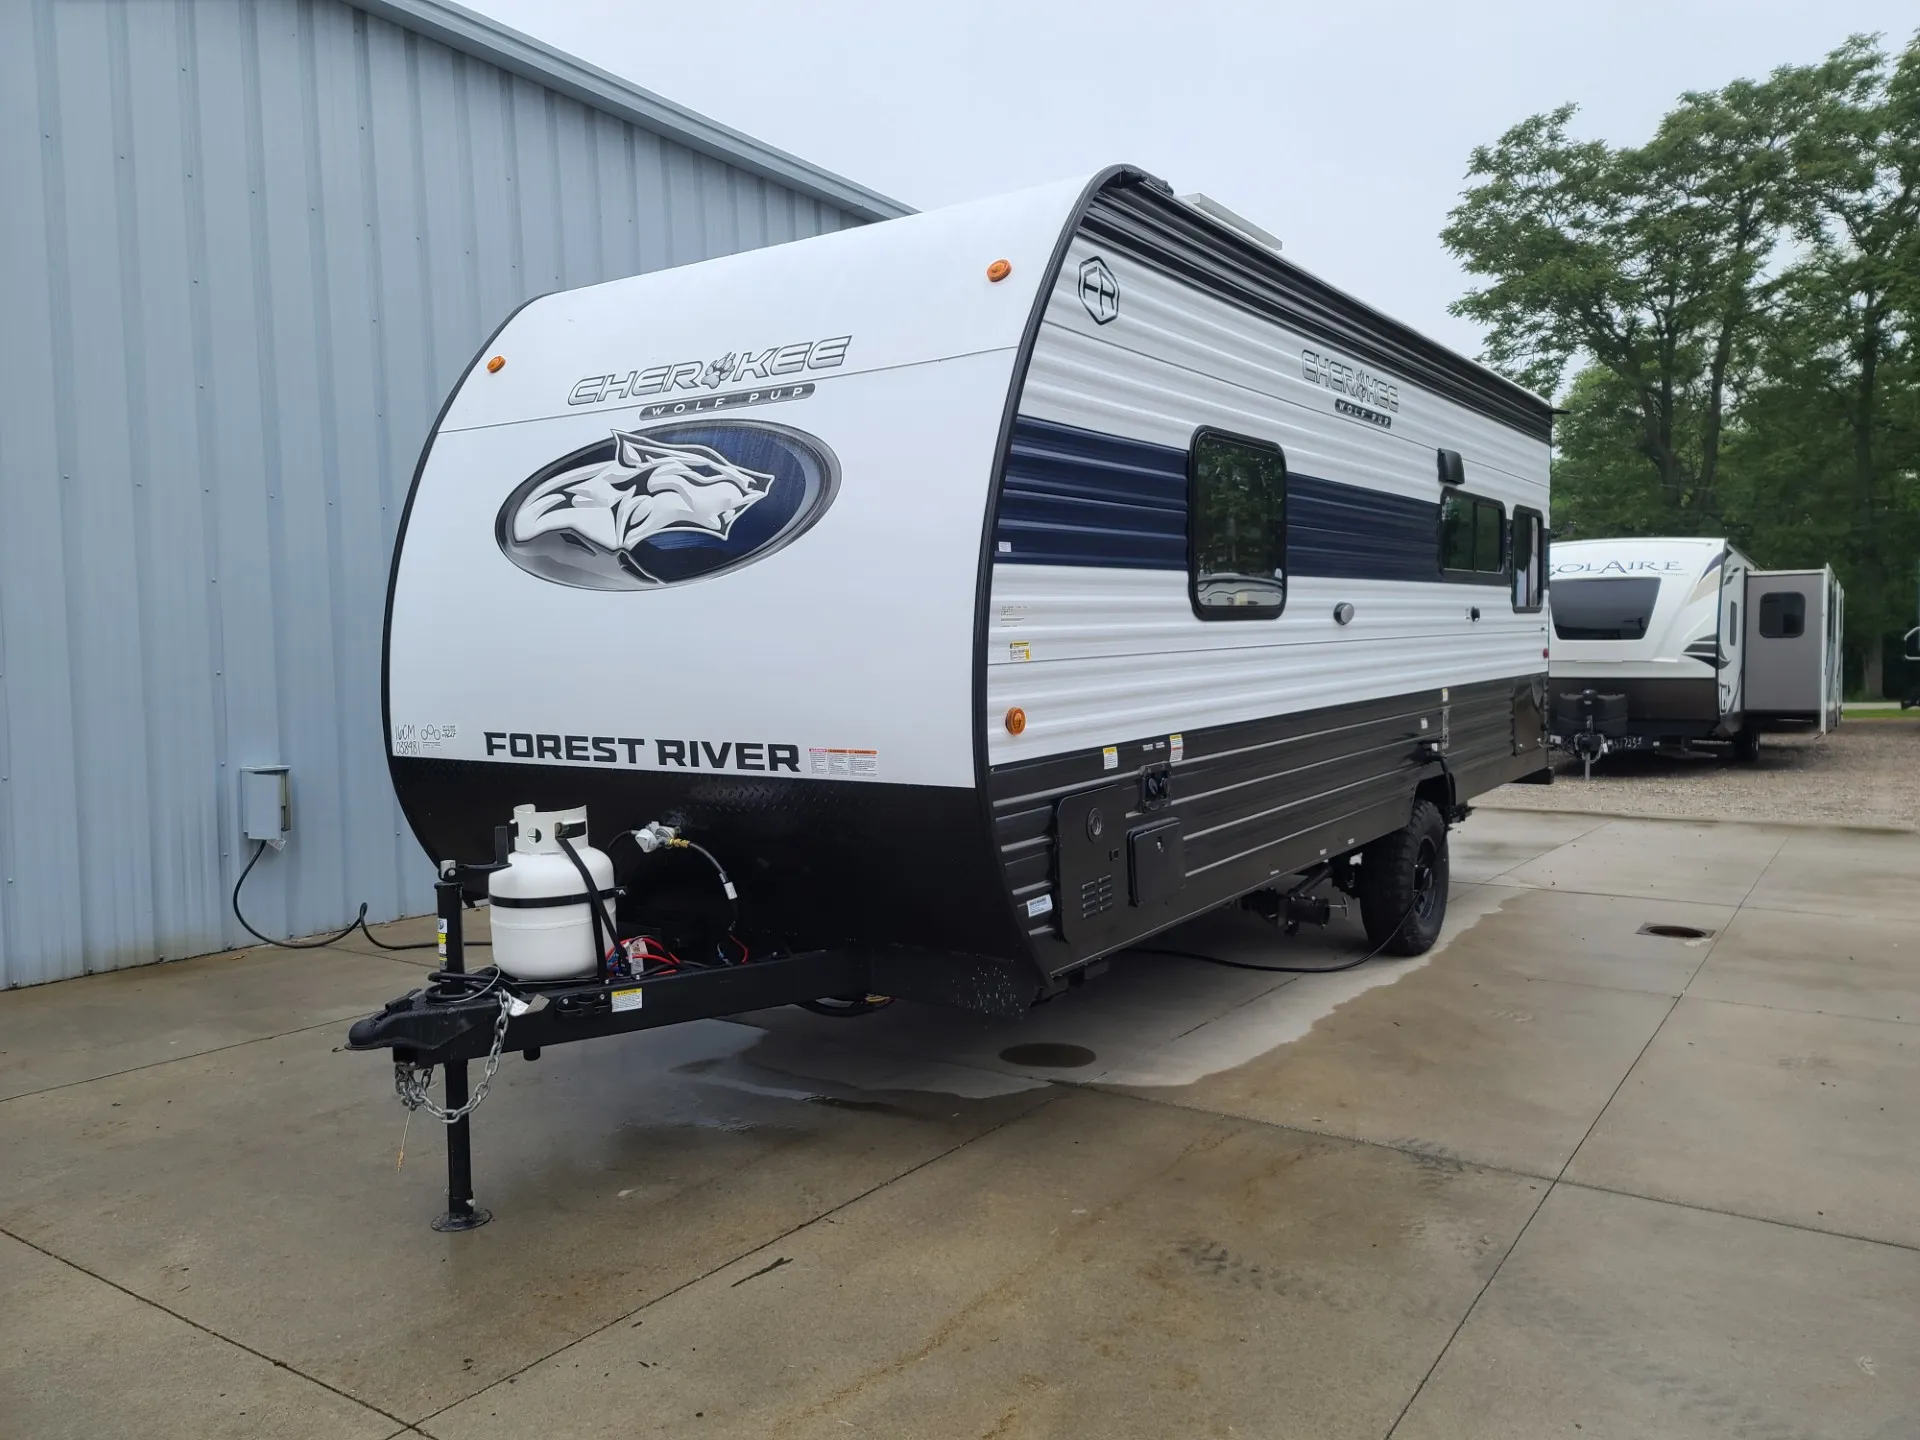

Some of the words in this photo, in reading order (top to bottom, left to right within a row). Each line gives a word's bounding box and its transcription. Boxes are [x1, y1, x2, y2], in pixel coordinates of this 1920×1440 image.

[651, 397, 726, 417] WOLF
[748, 386, 804, 404] PUP
[1338, 401, 1366, 418] WOLF
[1371, 412, 1390, 426] PUP
[483, 731, 645, 764] FOREST
[654, 738, 801, 773] RIVER
